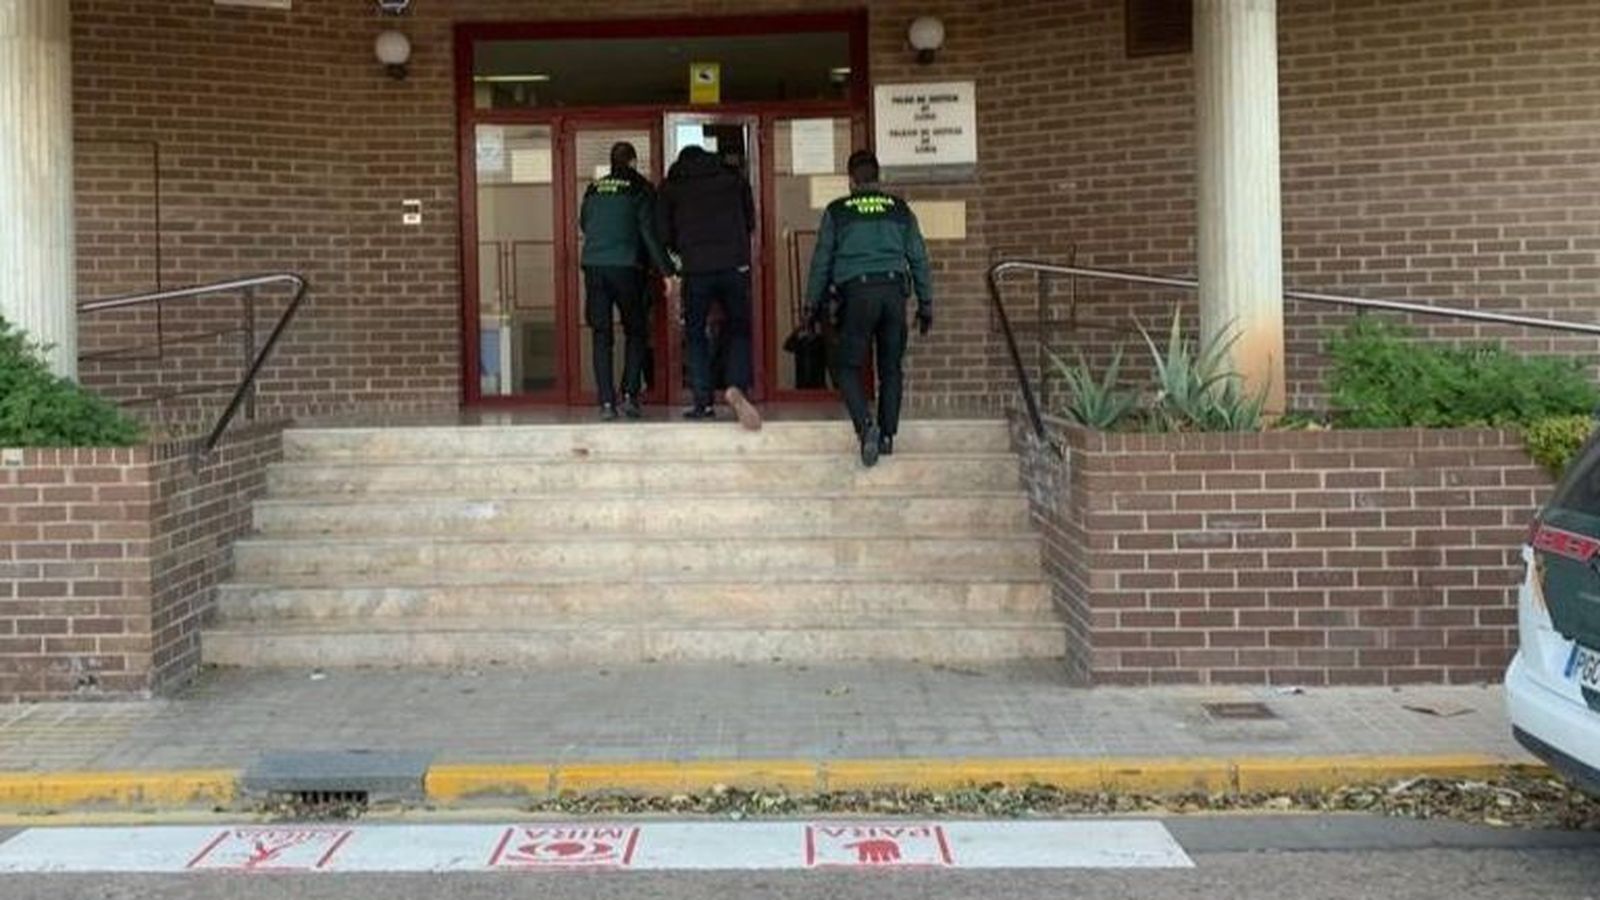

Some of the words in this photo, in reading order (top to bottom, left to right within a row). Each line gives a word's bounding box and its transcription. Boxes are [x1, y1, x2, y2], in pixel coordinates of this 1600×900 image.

[844, 196, 895, 206] GUARDIA
[525, 827, 624, 840] MIRA
[820, 826, 931, 839] PARA
